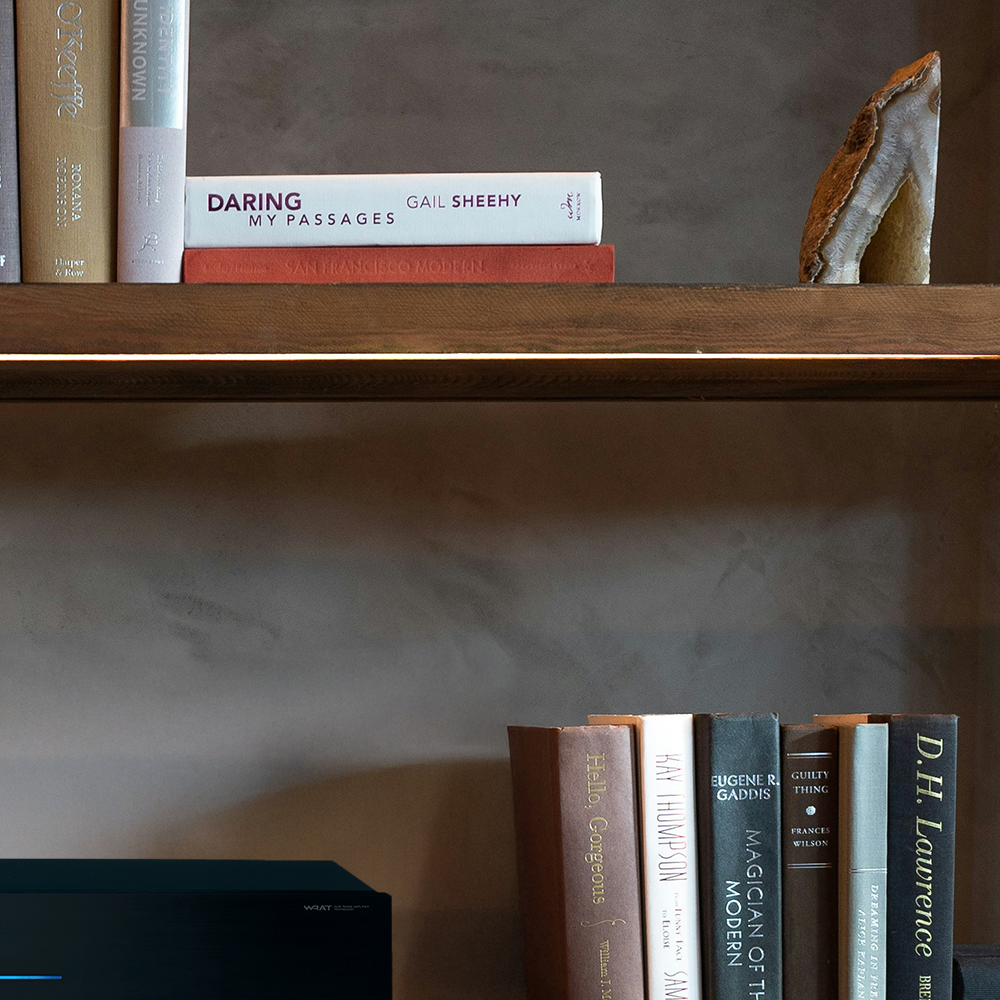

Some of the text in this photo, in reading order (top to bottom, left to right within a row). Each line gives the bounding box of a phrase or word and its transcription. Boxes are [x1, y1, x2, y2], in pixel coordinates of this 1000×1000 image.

[206, 191, 302, 213] DARING
[405, 193, 522, 210] GAIL SHEEHY
[248, 212, 395, 227] MY PASSAGES
[55, 258, 85, 269] Harper
[65, 269, 85, 277] Row
[710, 773, 781, 787] EUGENE R.
[790, 770, 830, 780] GUILTY
[716, 788, 771, 801] GADDIS
[792, 785, 829, 794] THING
[655, 753, 688, 882] KAY THOMPSON
[790, 826, 830, 835] FRANCES
[792, 839, 829, 848] WILSON
[584, 815, 609, 906] Gorgeous
[745, 829, 765, 938] MAGICIAN
[915, 815, 943, 958] Lawrence
[725, 880, 743, 967] MODERN
[870, 884, 880, 951] DREAMING
[599, 939, 610, 978] William
[748, 946, 765, 972] OF
[663, 970, 689, 1000] SAM
[856, 949, 867, 1000] KAPLAN
